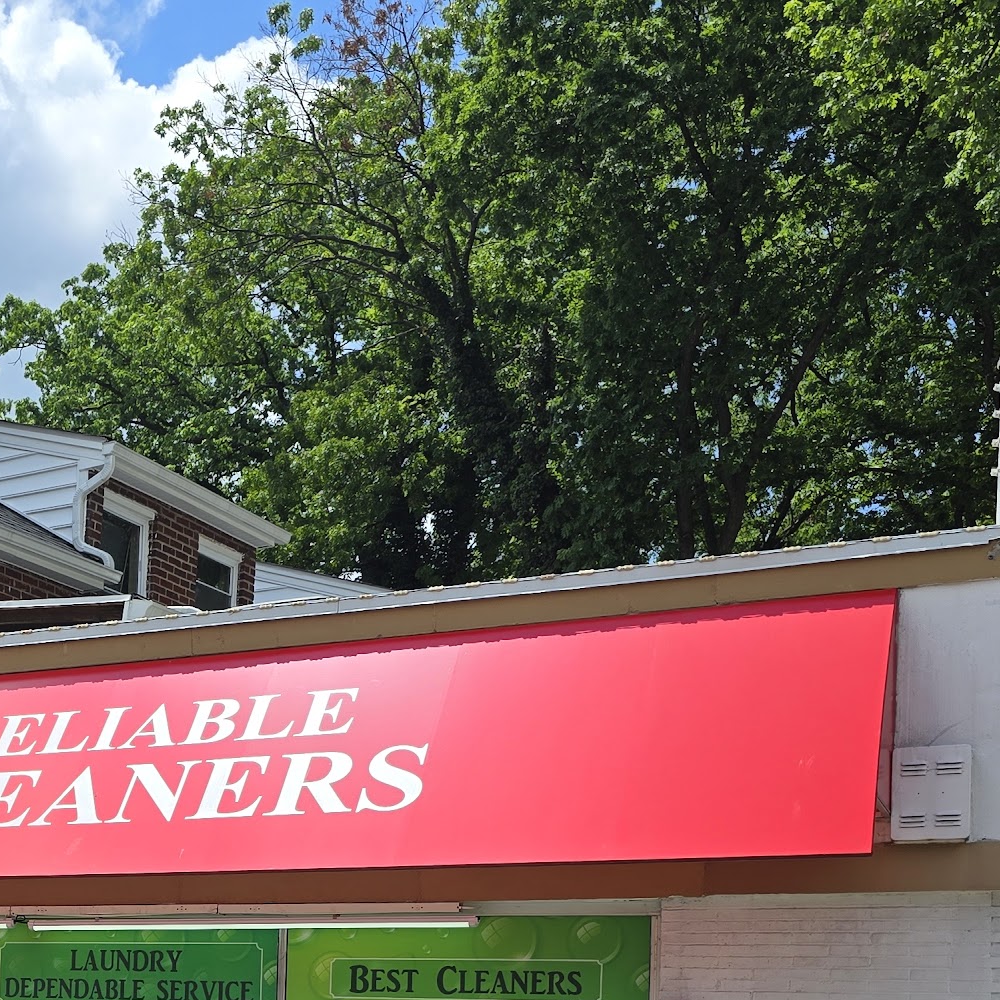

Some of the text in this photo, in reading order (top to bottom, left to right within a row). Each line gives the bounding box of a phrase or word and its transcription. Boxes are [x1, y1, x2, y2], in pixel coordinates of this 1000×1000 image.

[70, 950, 183, 973] LAUNDRY
[4, 977, 145, 1000] DEPENDABLE
[349, 964, 583, 996] BEST CLEANERS
